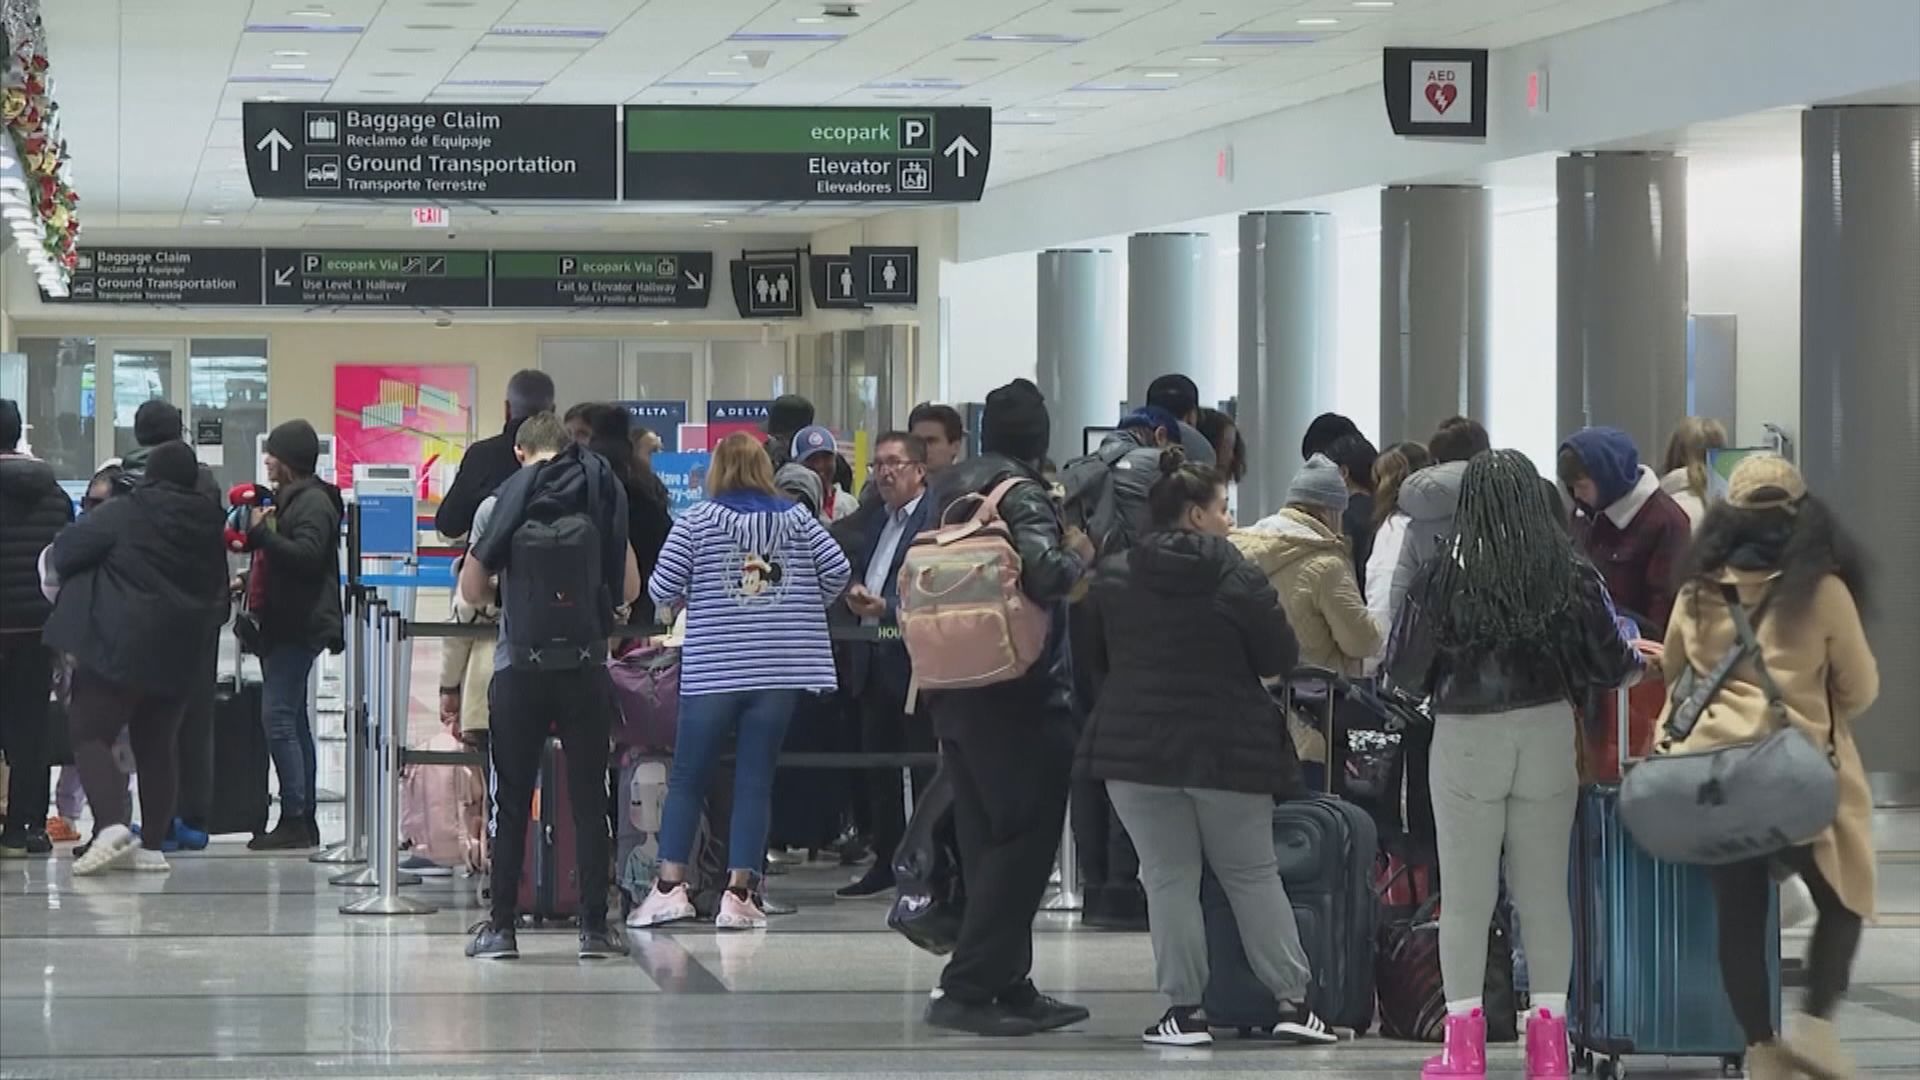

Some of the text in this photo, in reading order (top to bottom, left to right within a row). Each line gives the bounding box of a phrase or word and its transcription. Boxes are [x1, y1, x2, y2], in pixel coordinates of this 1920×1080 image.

[1428, 70, 1456, 82] AED
[347, 111, 501, 132] Baggage Claim
[811, 121, 924, 146] ecopark P
[347, 134, 492, 150] Reclamo de Equipaje
[347, 155, 577, 176] Ground Transportation
[809, 157, 891, 175] Elevator
[347, 178, 487, 193] Transporte Terrestre
[817, 180, 892, 194] Elevadores
[419, 208, 442, 223] EXIT
[97, 251, 191, 265] Baggage Claim
[307, 257, 398, 272] P ecopark Via
[149, 266, 185, 275] Equipaje
[562, 259, 653, 274] P ecopark Via
[97, 277, 237, 291] Ground Transportation
[303, 279, 408, 293] Use Level 1 Hallway
[557, 281, 677, 294] Exit to Elevator Hallway
